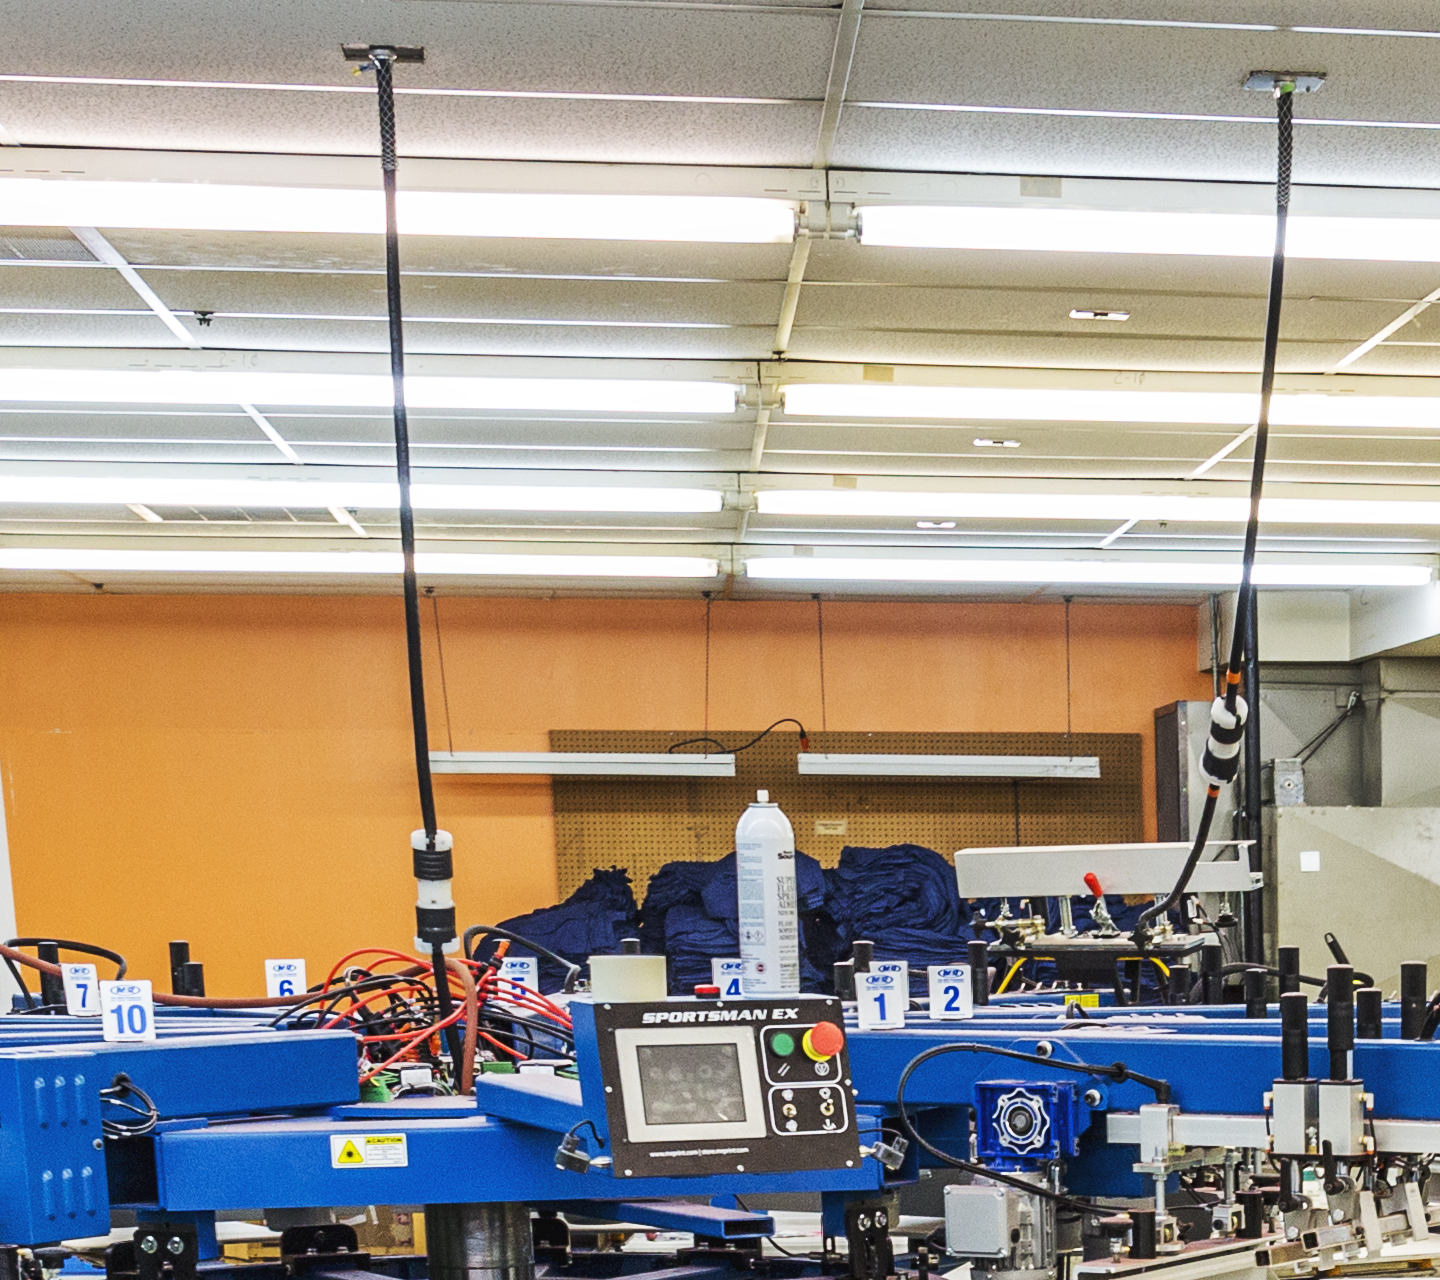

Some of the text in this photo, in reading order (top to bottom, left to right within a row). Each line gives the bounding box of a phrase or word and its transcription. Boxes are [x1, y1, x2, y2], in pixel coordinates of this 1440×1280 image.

[76, 983, 89, 1008] 7
[279, 980, 294, 996] 6
[726, 978, 741, 995] 4
[943, 986, 960, 1011] 2
[110, 1004, 147, 1034] 10
[642, 1008, 799, 1024] SPORTSMAN EX
[873, 993, 886, 1020] 1
